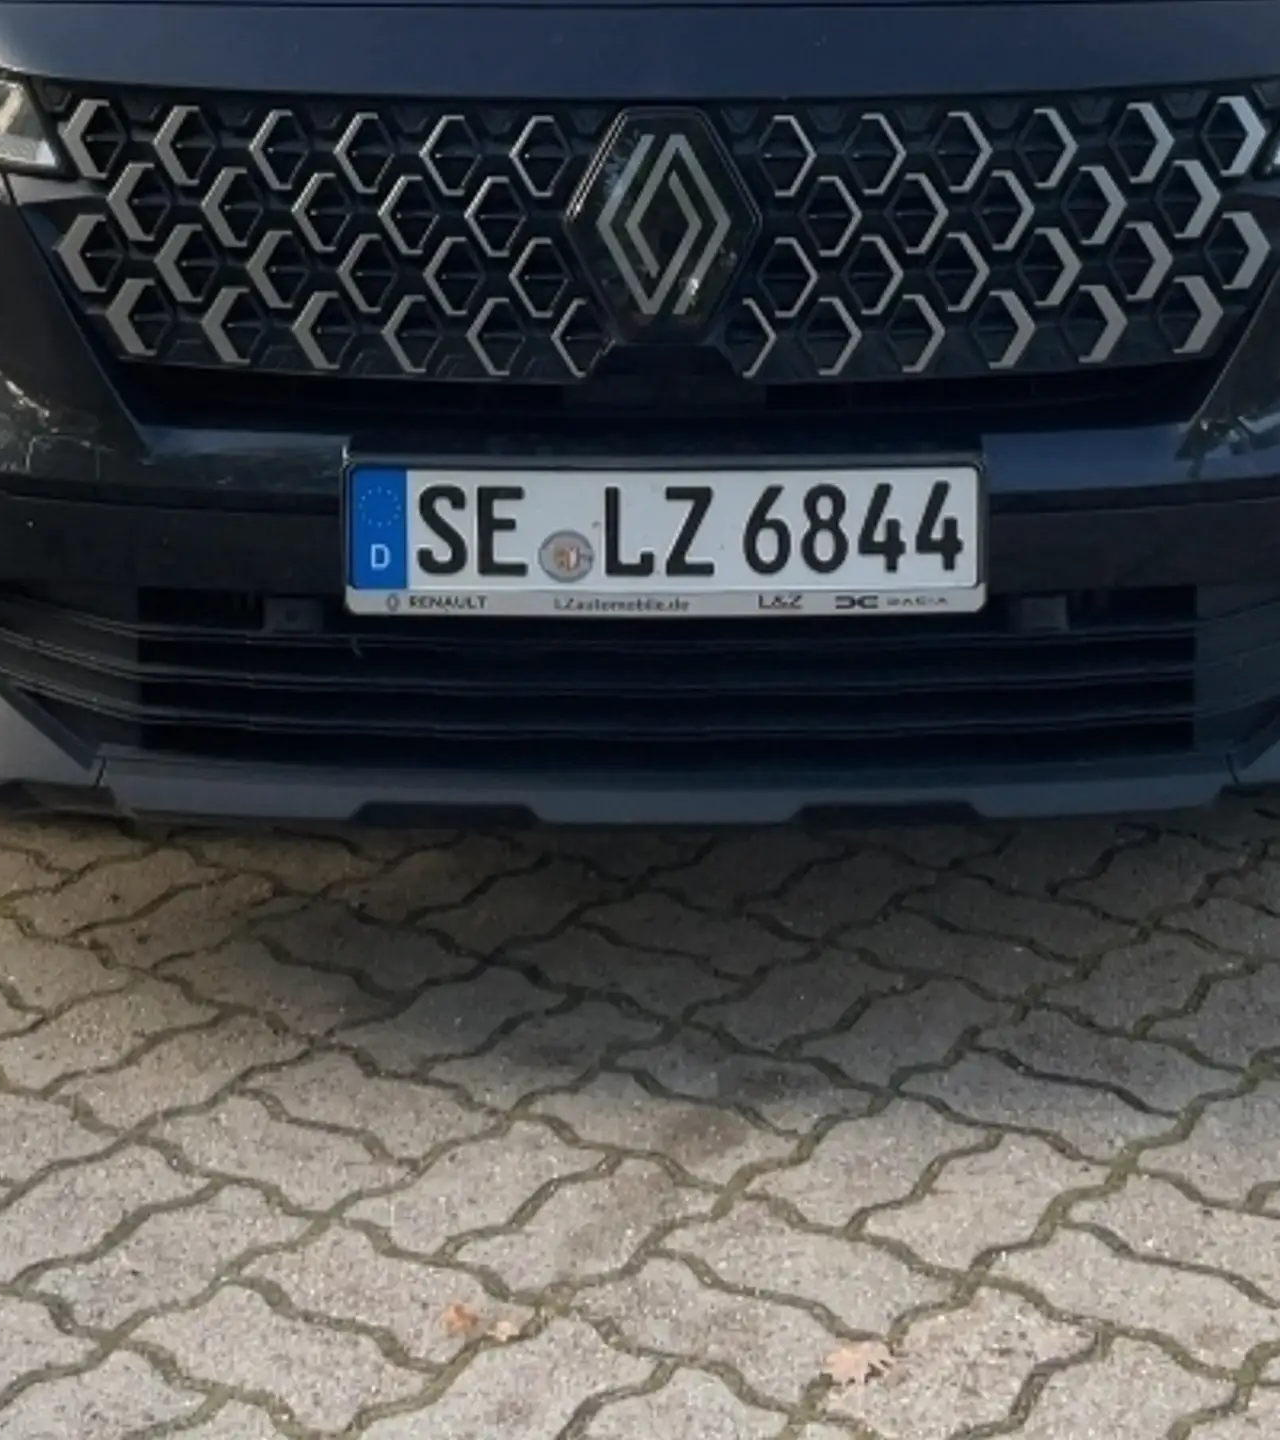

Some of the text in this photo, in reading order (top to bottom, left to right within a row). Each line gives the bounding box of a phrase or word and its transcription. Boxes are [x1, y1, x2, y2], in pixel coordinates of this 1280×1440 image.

[417, 480, 964, 577] SE LZ 6844
[370, 544, 391, 570] D
[408, 595, 488, 610] RENAULT
[757, 594, 803, 610] L&Z
